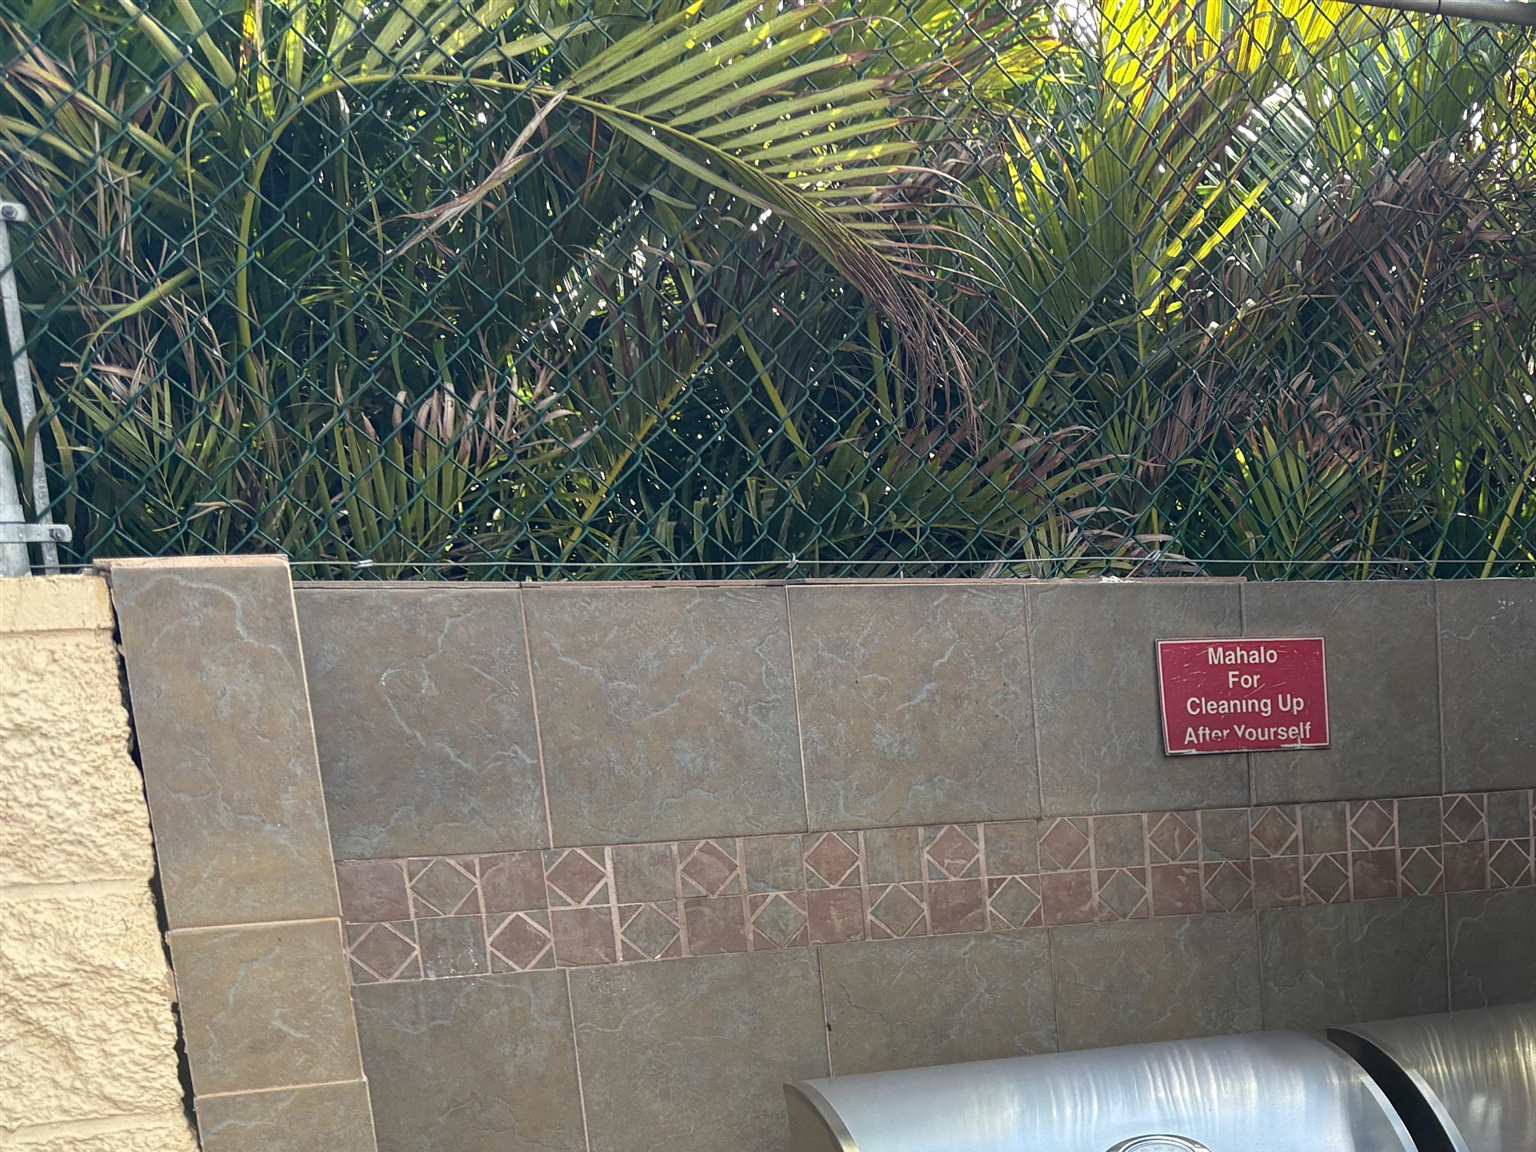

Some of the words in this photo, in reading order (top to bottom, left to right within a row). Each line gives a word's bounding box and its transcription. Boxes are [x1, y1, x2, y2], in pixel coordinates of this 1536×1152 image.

[1208, 646, 1278, 665] Mahalo
[1228, 671, 1261, 688] For
[1186, 697, 1272, 716] Cleaning
[1278, 694, 1304, 715] Up
[1184, 726, 1230, 744] After
[1233, 722, 1312, 742] Yourself
